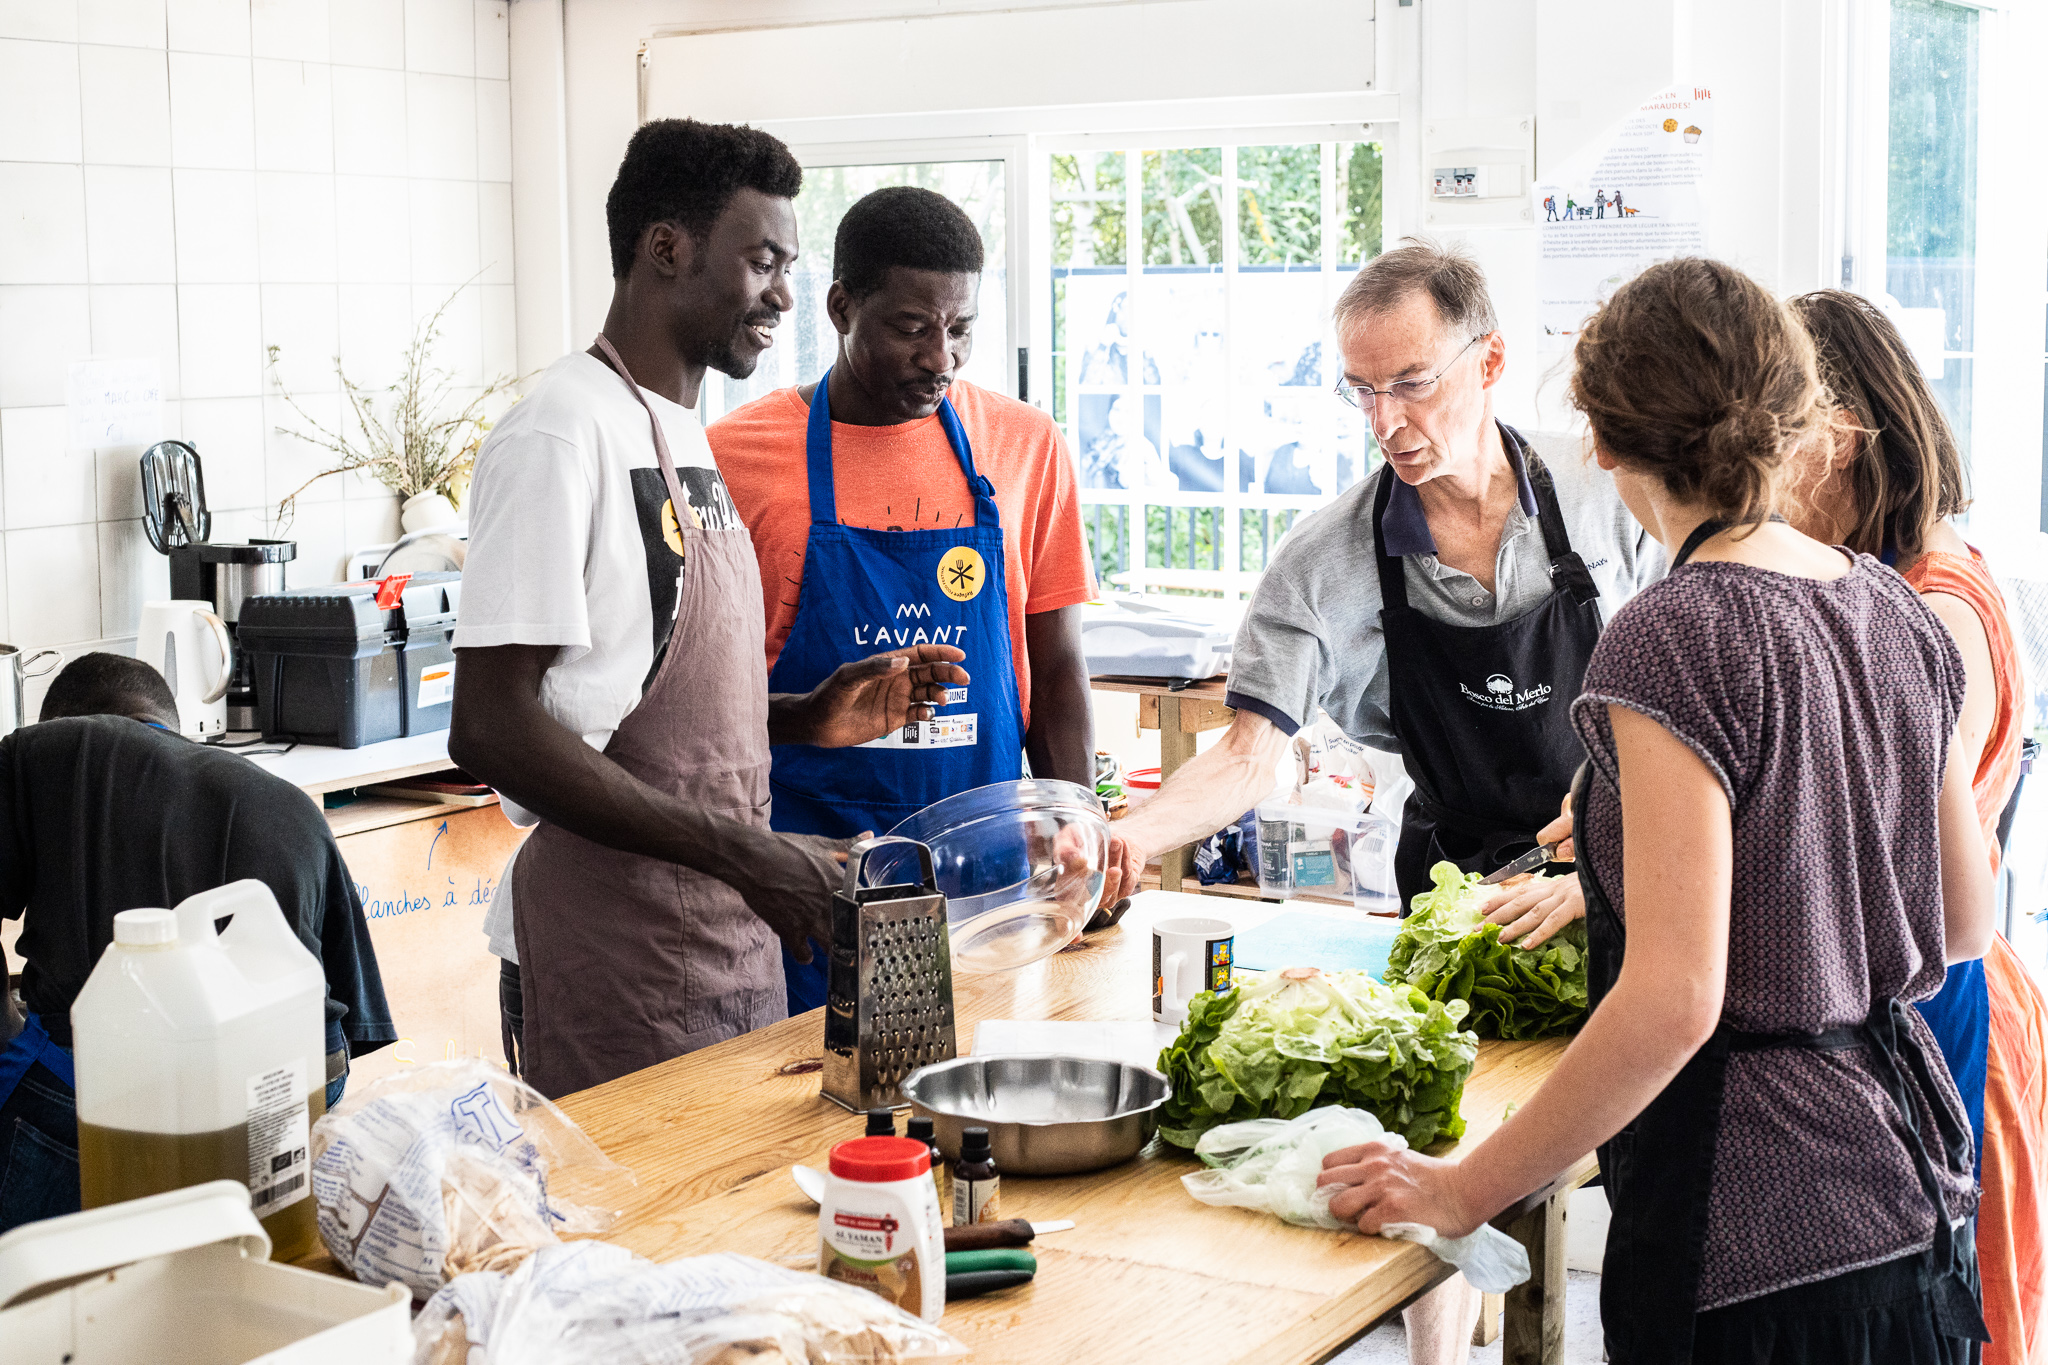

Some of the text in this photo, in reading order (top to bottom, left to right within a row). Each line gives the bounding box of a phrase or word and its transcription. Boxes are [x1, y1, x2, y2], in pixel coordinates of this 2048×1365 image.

[1640, 102, 1691, 111] MARAUDES!
[104, 390, 130, 406] MARC
[854, 624, 967, 647] L'AVANT
[1459, 683, 1552, 705] Bosco del Merlo
[443, 876, 458, 908] à
